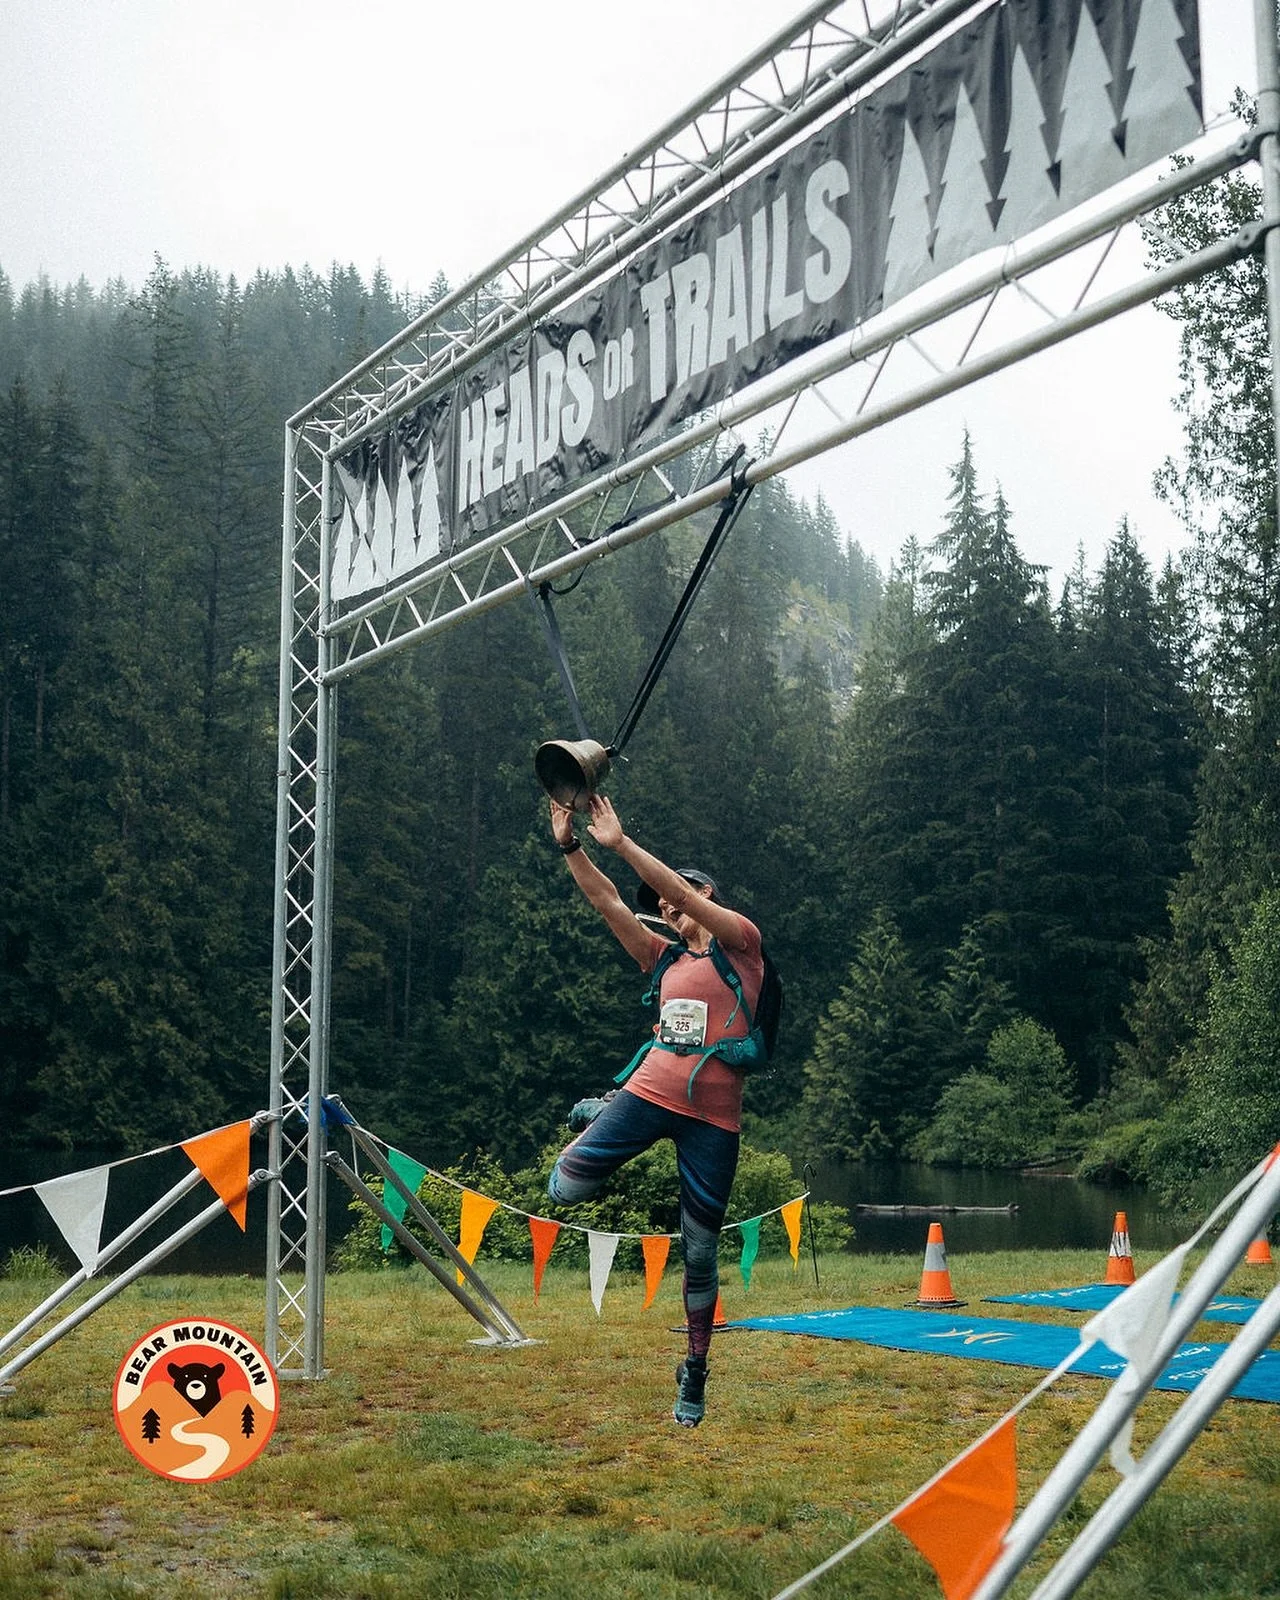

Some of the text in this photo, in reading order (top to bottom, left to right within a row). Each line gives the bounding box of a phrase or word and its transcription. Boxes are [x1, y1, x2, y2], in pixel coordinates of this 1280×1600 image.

[459, 159, 852, 513] HEADS OR TRAILS
[674, 1020, 691, 1032] 325
